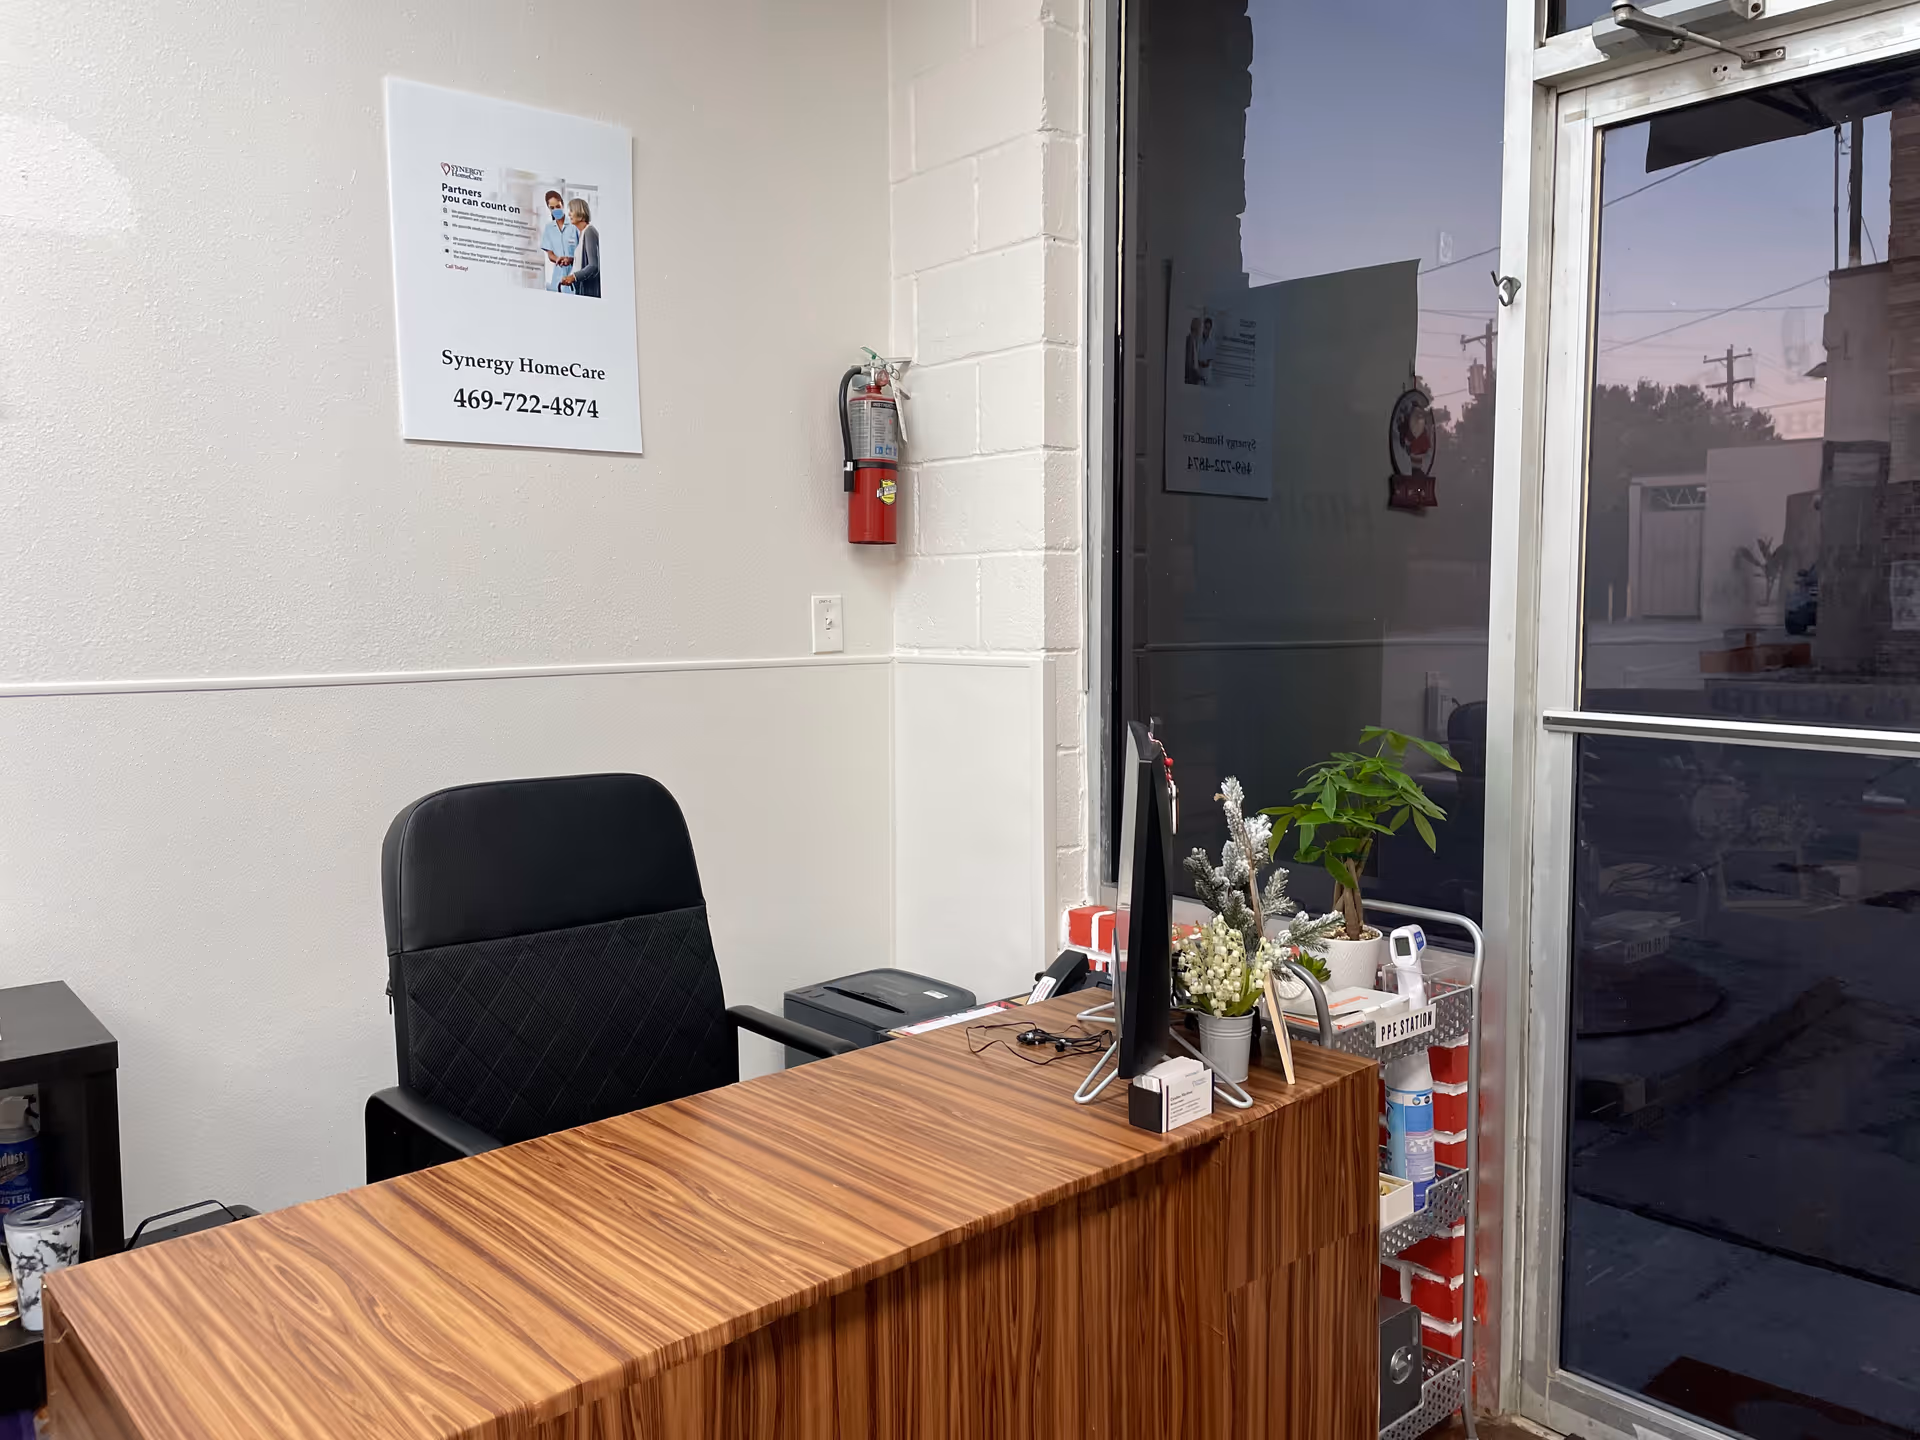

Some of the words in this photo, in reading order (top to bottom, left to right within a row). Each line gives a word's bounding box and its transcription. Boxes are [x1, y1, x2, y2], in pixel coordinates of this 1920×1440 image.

[451, 164, 482, 176] SYNERGY
[451, 170, 482, 181] HomeCare
[442, 183, 482, 198] Partners
[442, 194, 460, 203] you
[462, 198, 479, 207] can
[481, 201, 507, 212] count
[441, 349, 514, 376] Synergy
[519, 357, 606, 381] HomeCare
[453, 387, 600, 419] 469-722-4874
[1381, 1021, 1397, 1042] PPE
[1400, 1010, 1433, 1036] STATION
[0, 1151, 24, 1168] dust
